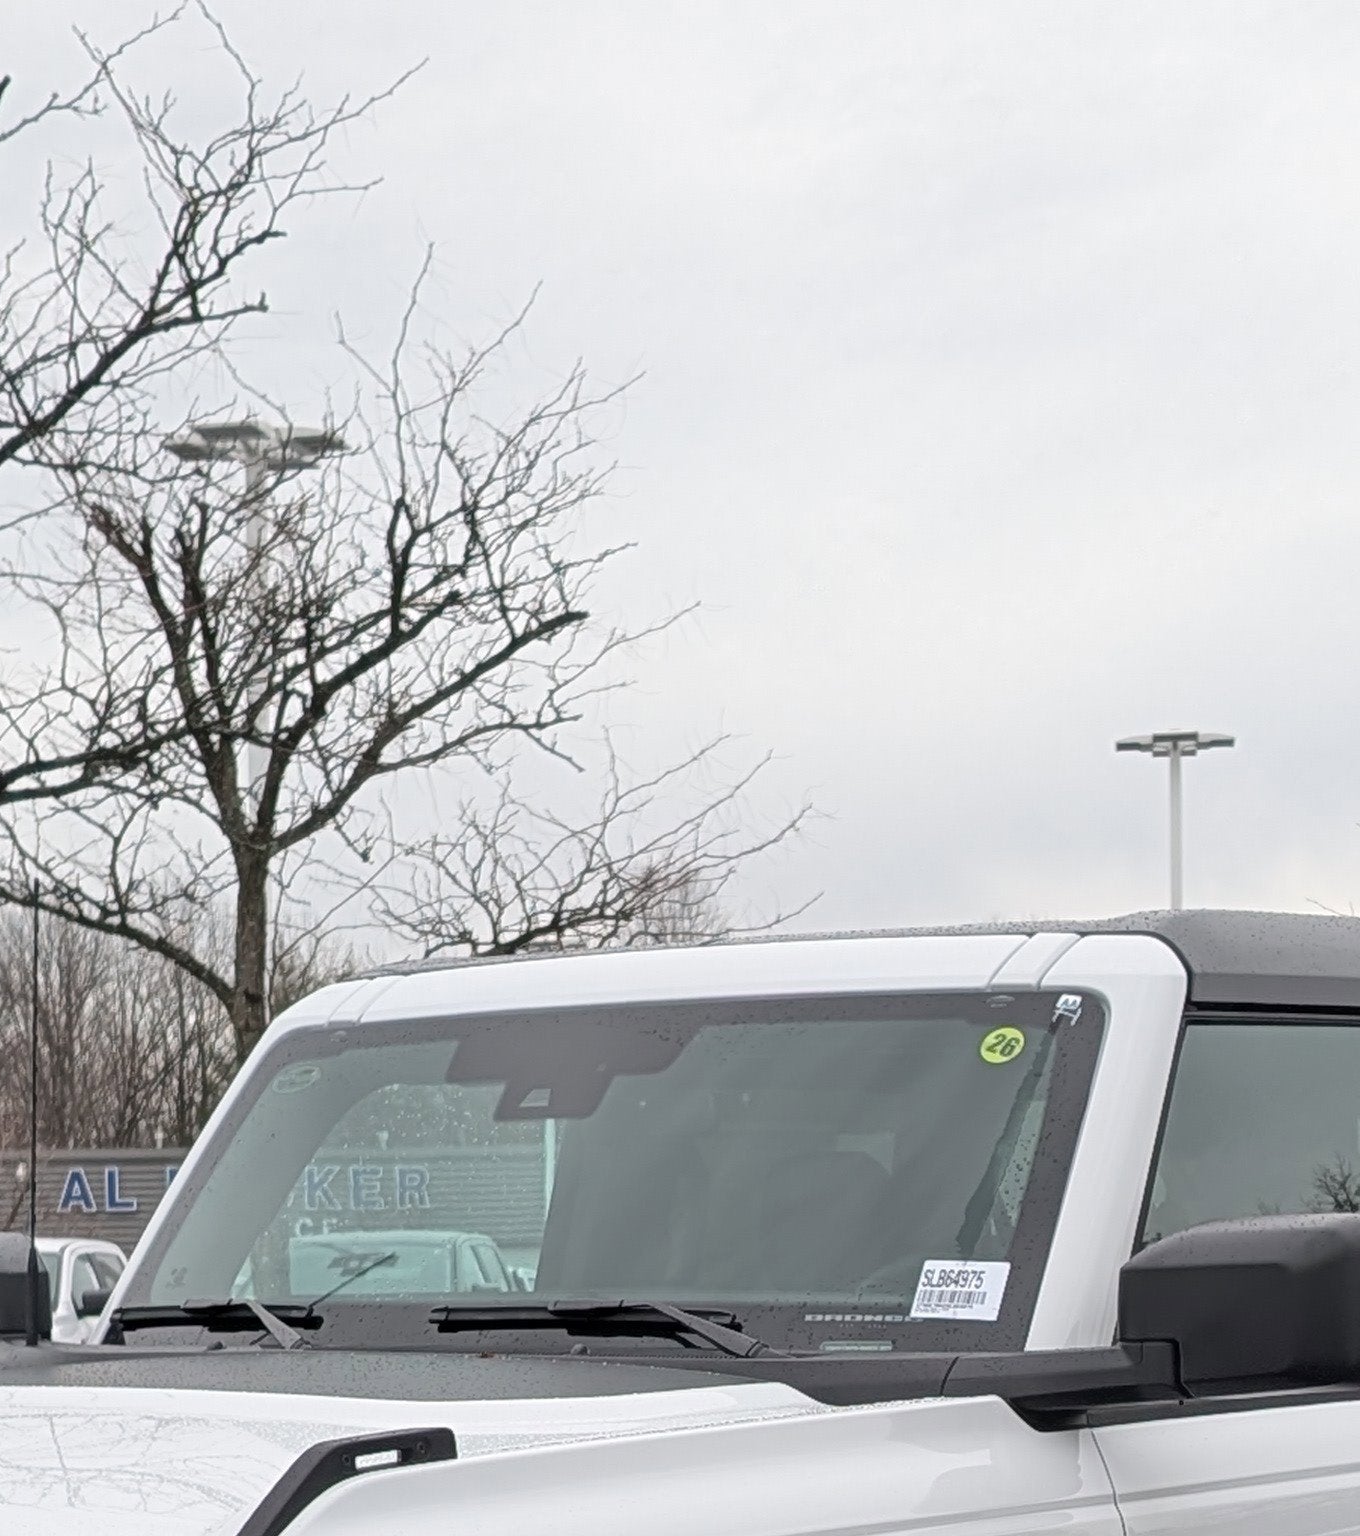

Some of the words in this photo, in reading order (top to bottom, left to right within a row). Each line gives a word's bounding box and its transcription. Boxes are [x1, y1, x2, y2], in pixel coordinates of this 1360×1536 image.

[985, 1033, 1021, 1058] 26
[56, 1165, 138, 1213] AL
[921, 1268, 986, 1290] SLB64975
